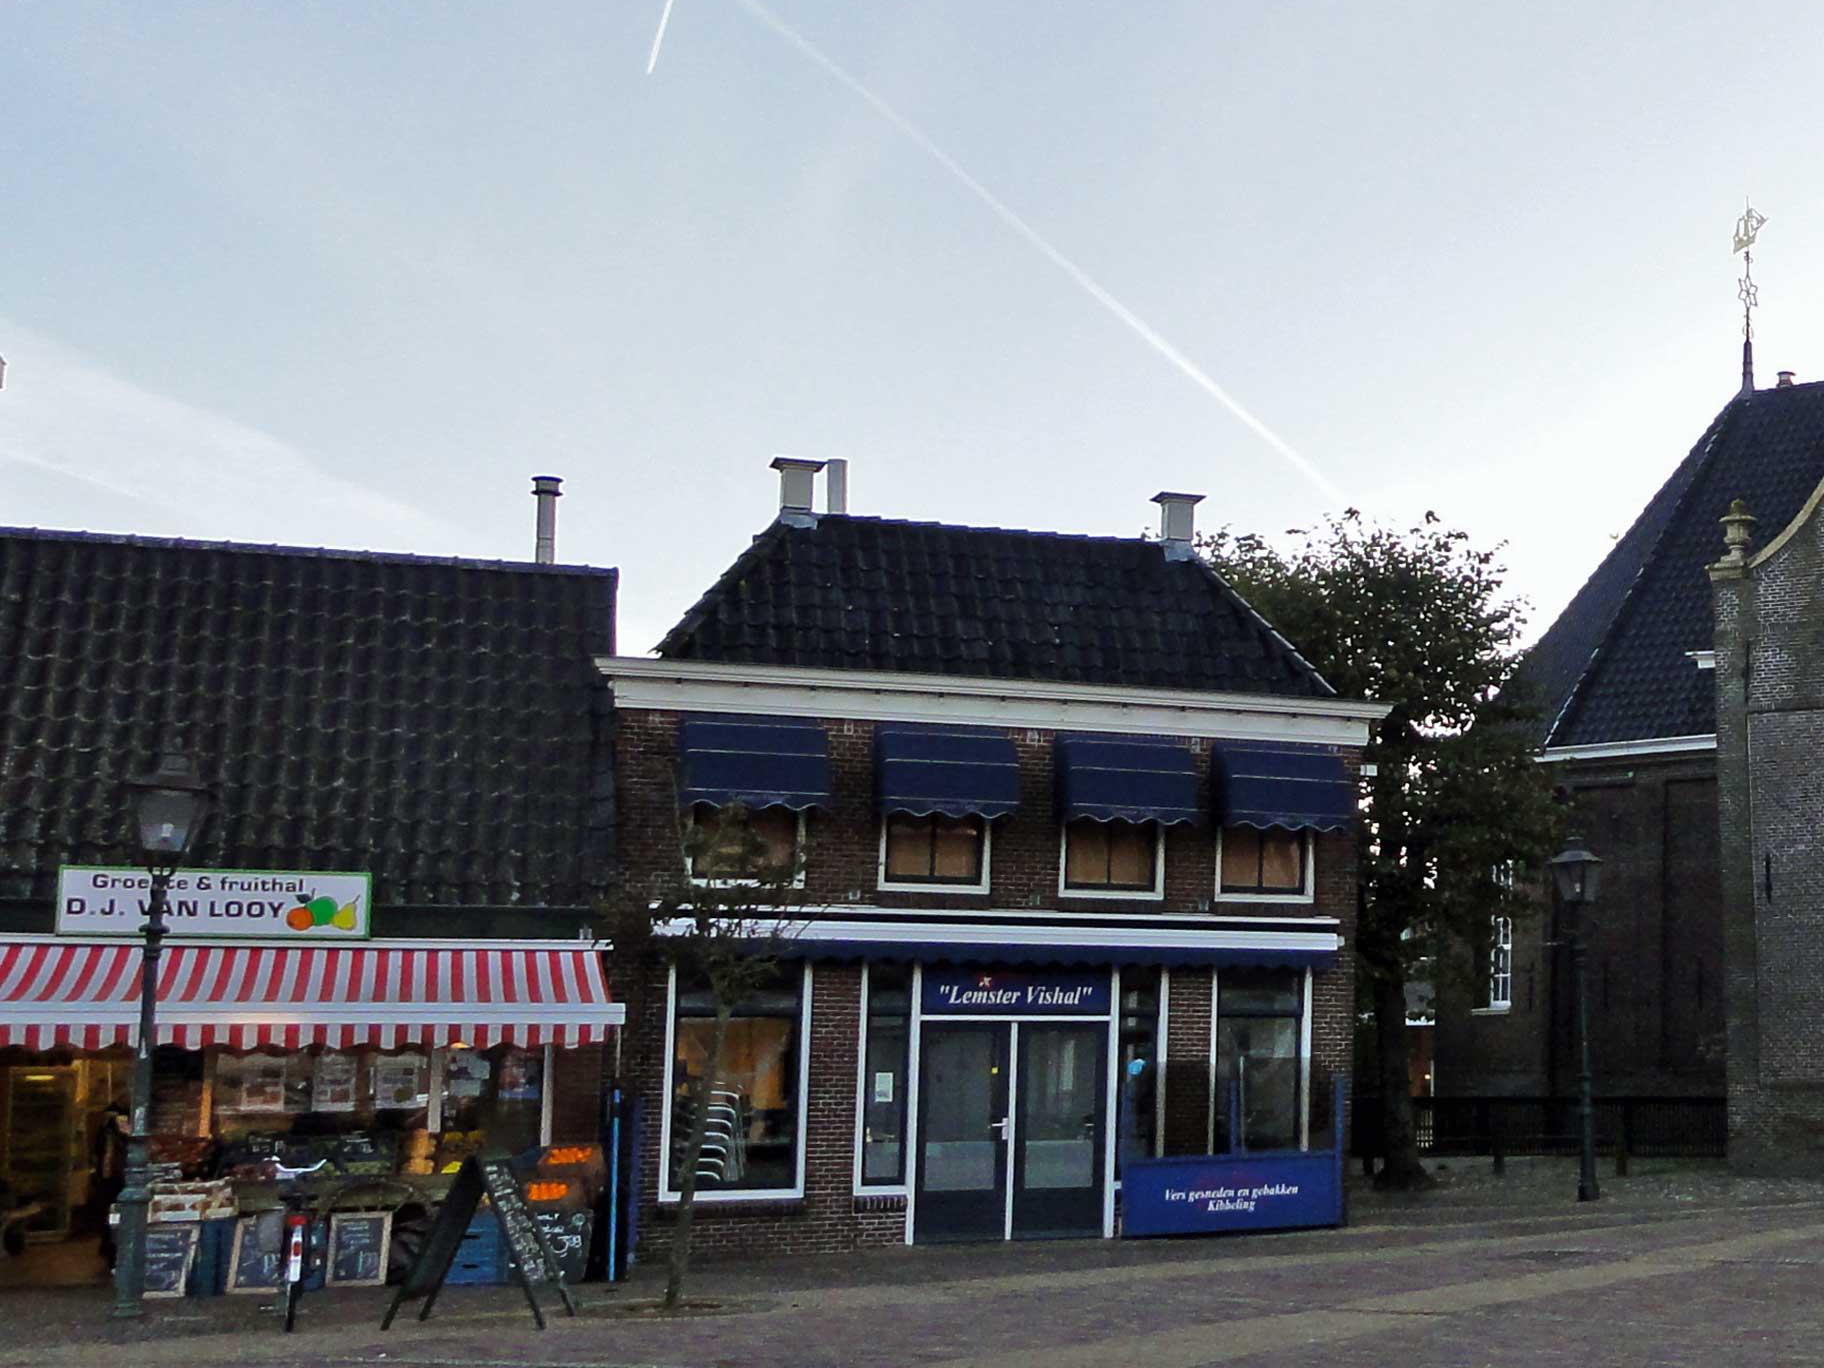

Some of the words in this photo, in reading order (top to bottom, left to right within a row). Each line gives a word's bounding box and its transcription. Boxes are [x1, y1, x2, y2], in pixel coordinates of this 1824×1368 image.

[92, 873, 188, 891] Groete
[196, 875, 212, 891] &
[220, 876, 304, 893] fruithal
[209, 900, 285, 918] LOOY
[939, 984, 1021, 1005] "Lemster
[1026, 985, 1093, 1005] Vishal"
[1165, 1189, 1186, 1201] Vers
[1237, 1188, 1250, 1197] en
[1251, 1183, 1299, 1199] gebakken
[1207, 1198, 1256, 1212] Kibbeling
